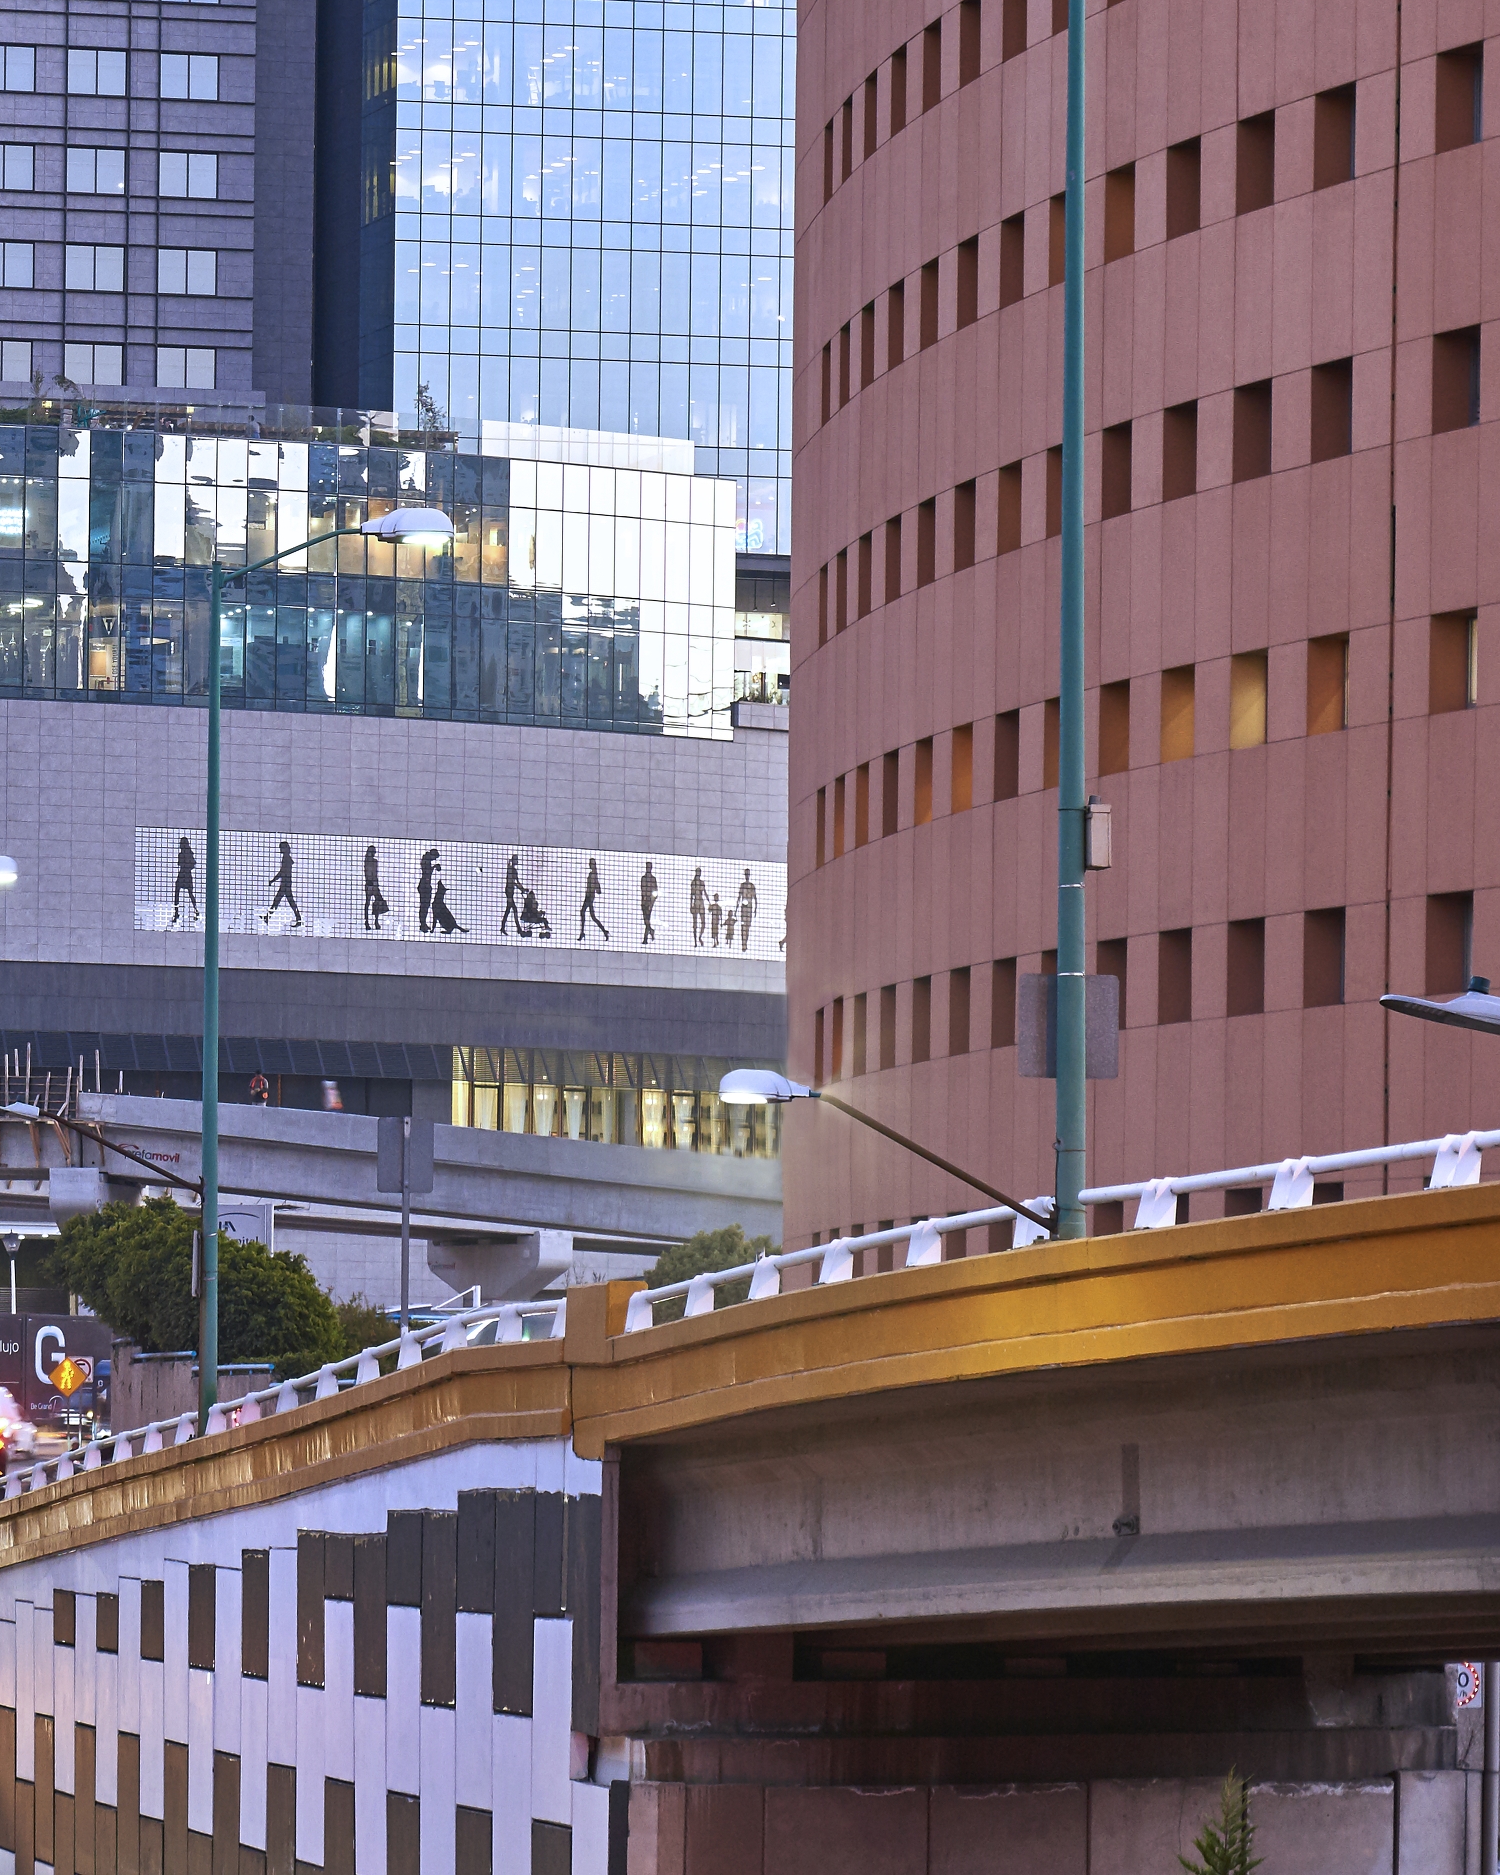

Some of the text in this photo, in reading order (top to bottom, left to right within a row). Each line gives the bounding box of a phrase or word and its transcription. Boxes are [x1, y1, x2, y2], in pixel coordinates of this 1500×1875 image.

[0, 1340, 20, 1355] lujo
[35, 1325, 66, 1385] G
[1458, 1672, 1469, 1687] 0
